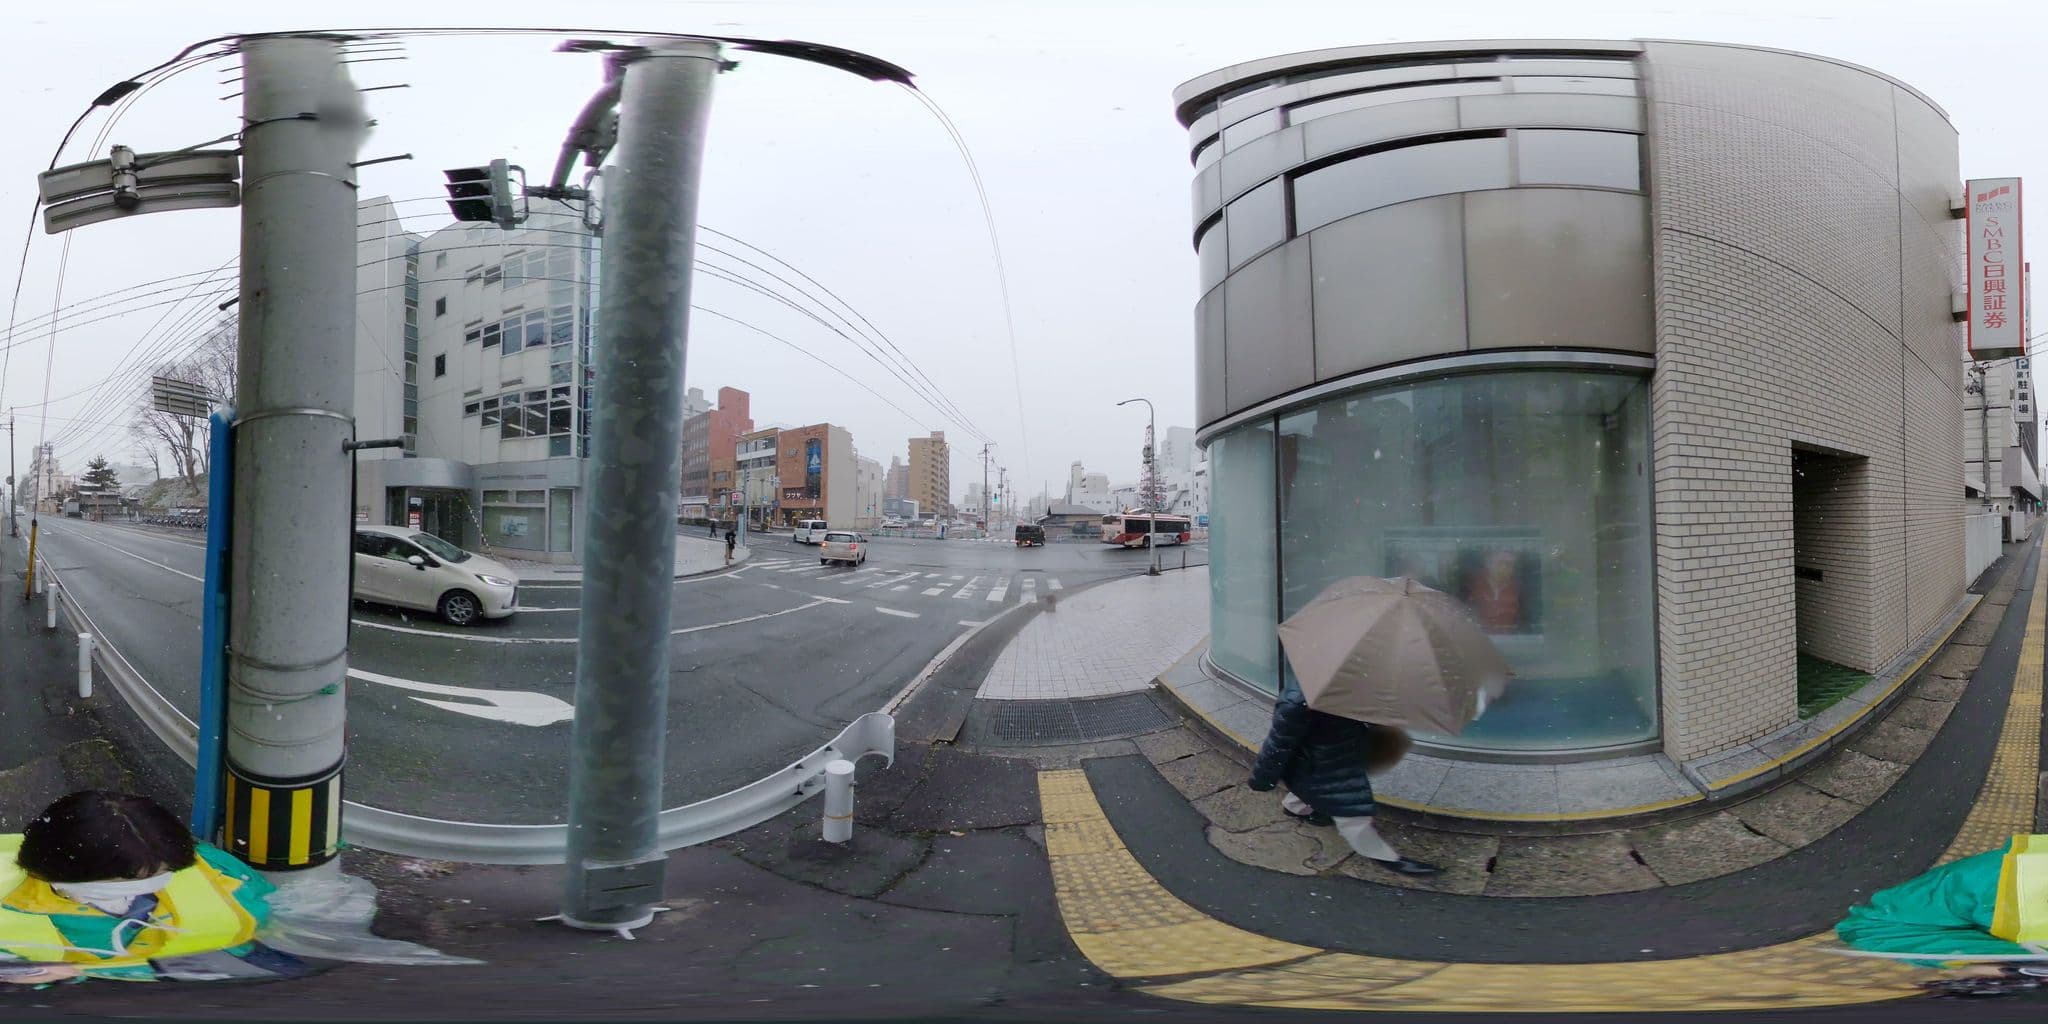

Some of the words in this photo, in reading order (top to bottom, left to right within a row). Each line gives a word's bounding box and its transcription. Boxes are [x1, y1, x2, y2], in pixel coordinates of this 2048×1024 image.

[1983, 216, 2008, 330] SMBC日興証券
[2018, 359, 2028, 369] P
[2017, 381, 2029, 413] 駐車場
